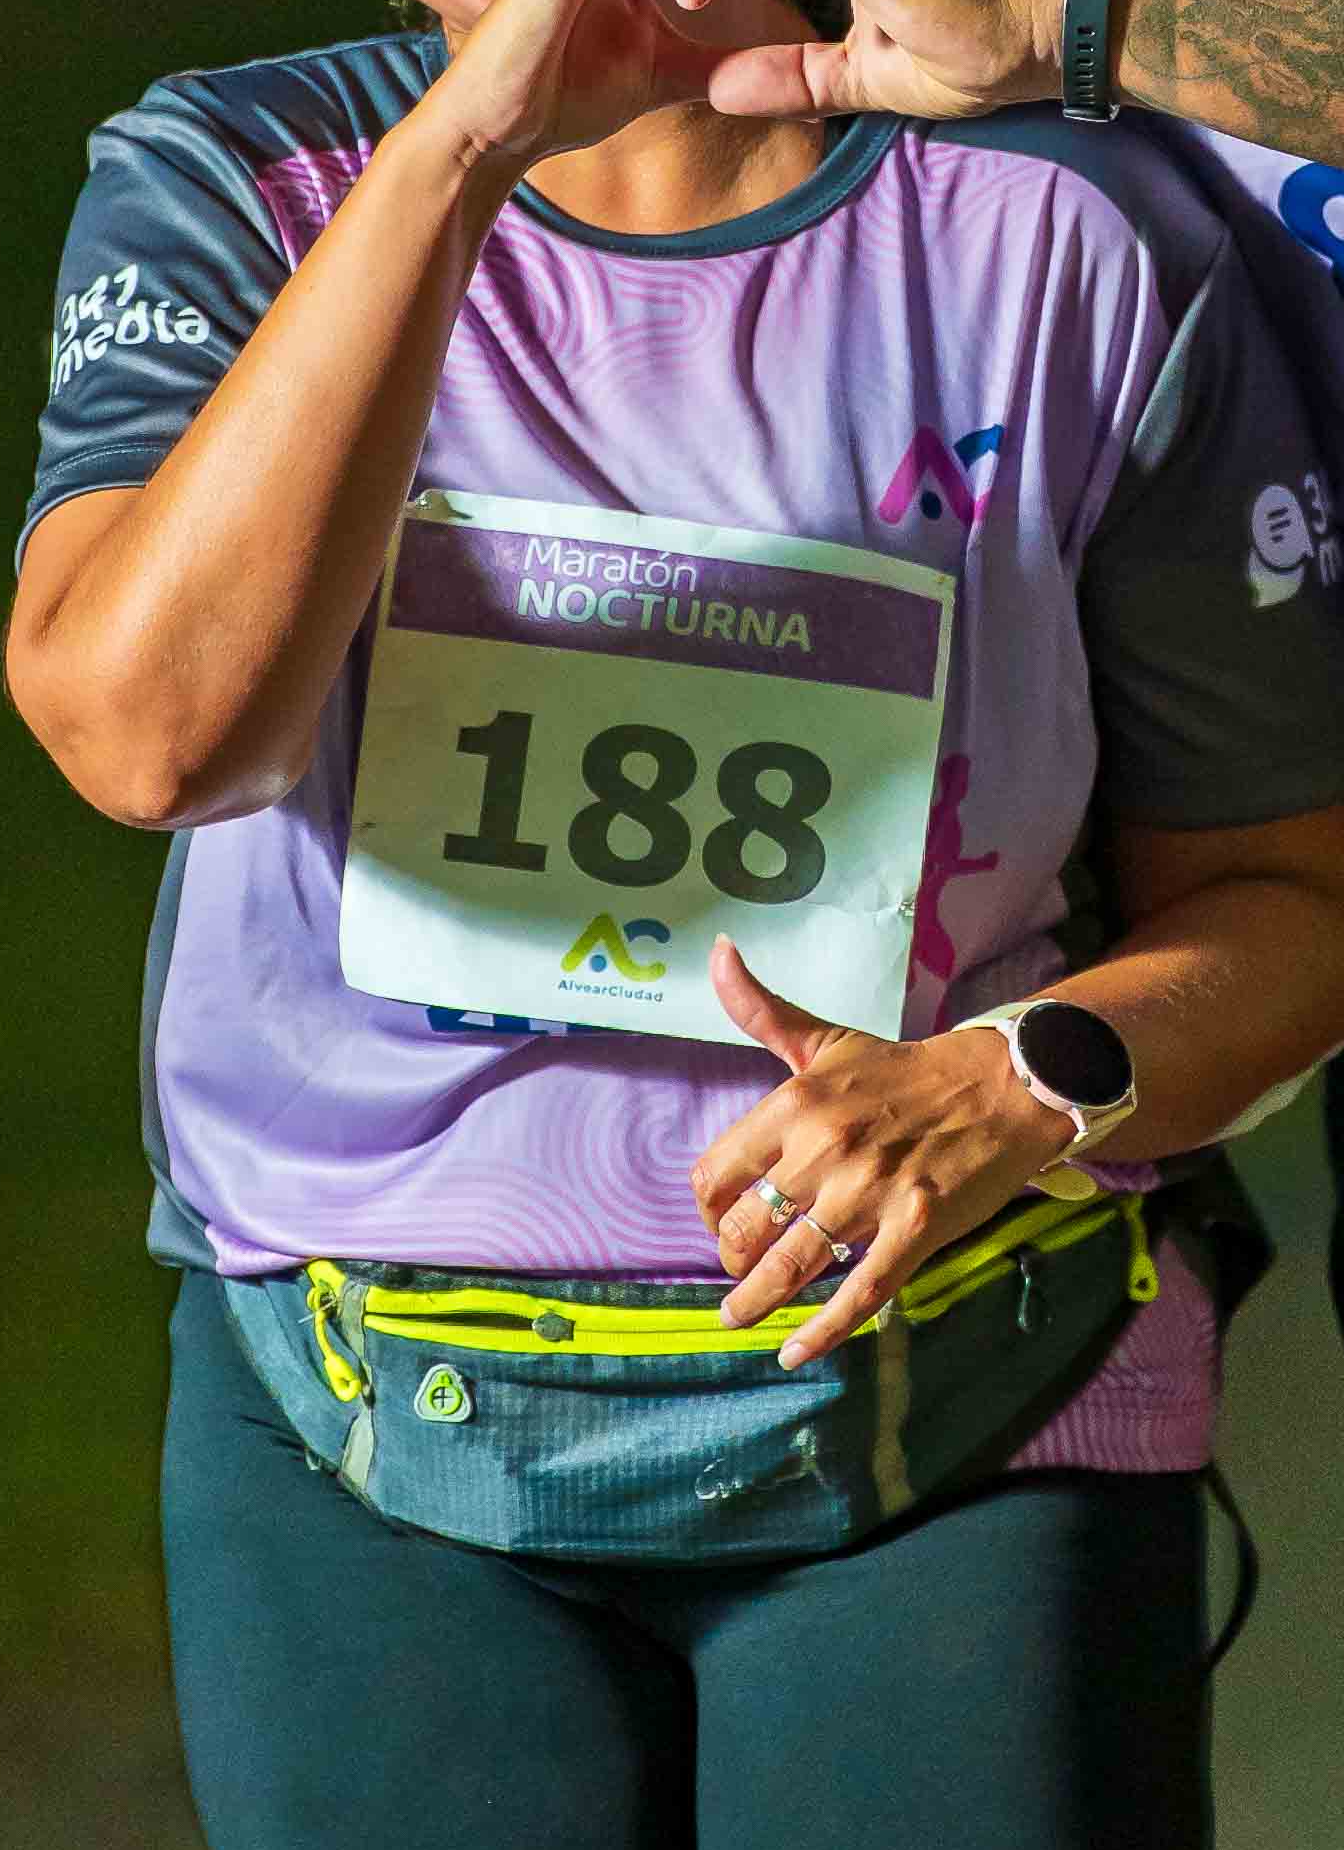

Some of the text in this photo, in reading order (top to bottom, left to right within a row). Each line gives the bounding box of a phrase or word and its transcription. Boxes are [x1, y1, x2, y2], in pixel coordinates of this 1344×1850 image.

[53, 300, 210, 396] media
[524, 537, 697, 592] Maratón
[516, 578, 812, 652] NOCTURNA
[443, 709, 833, 905] 188
